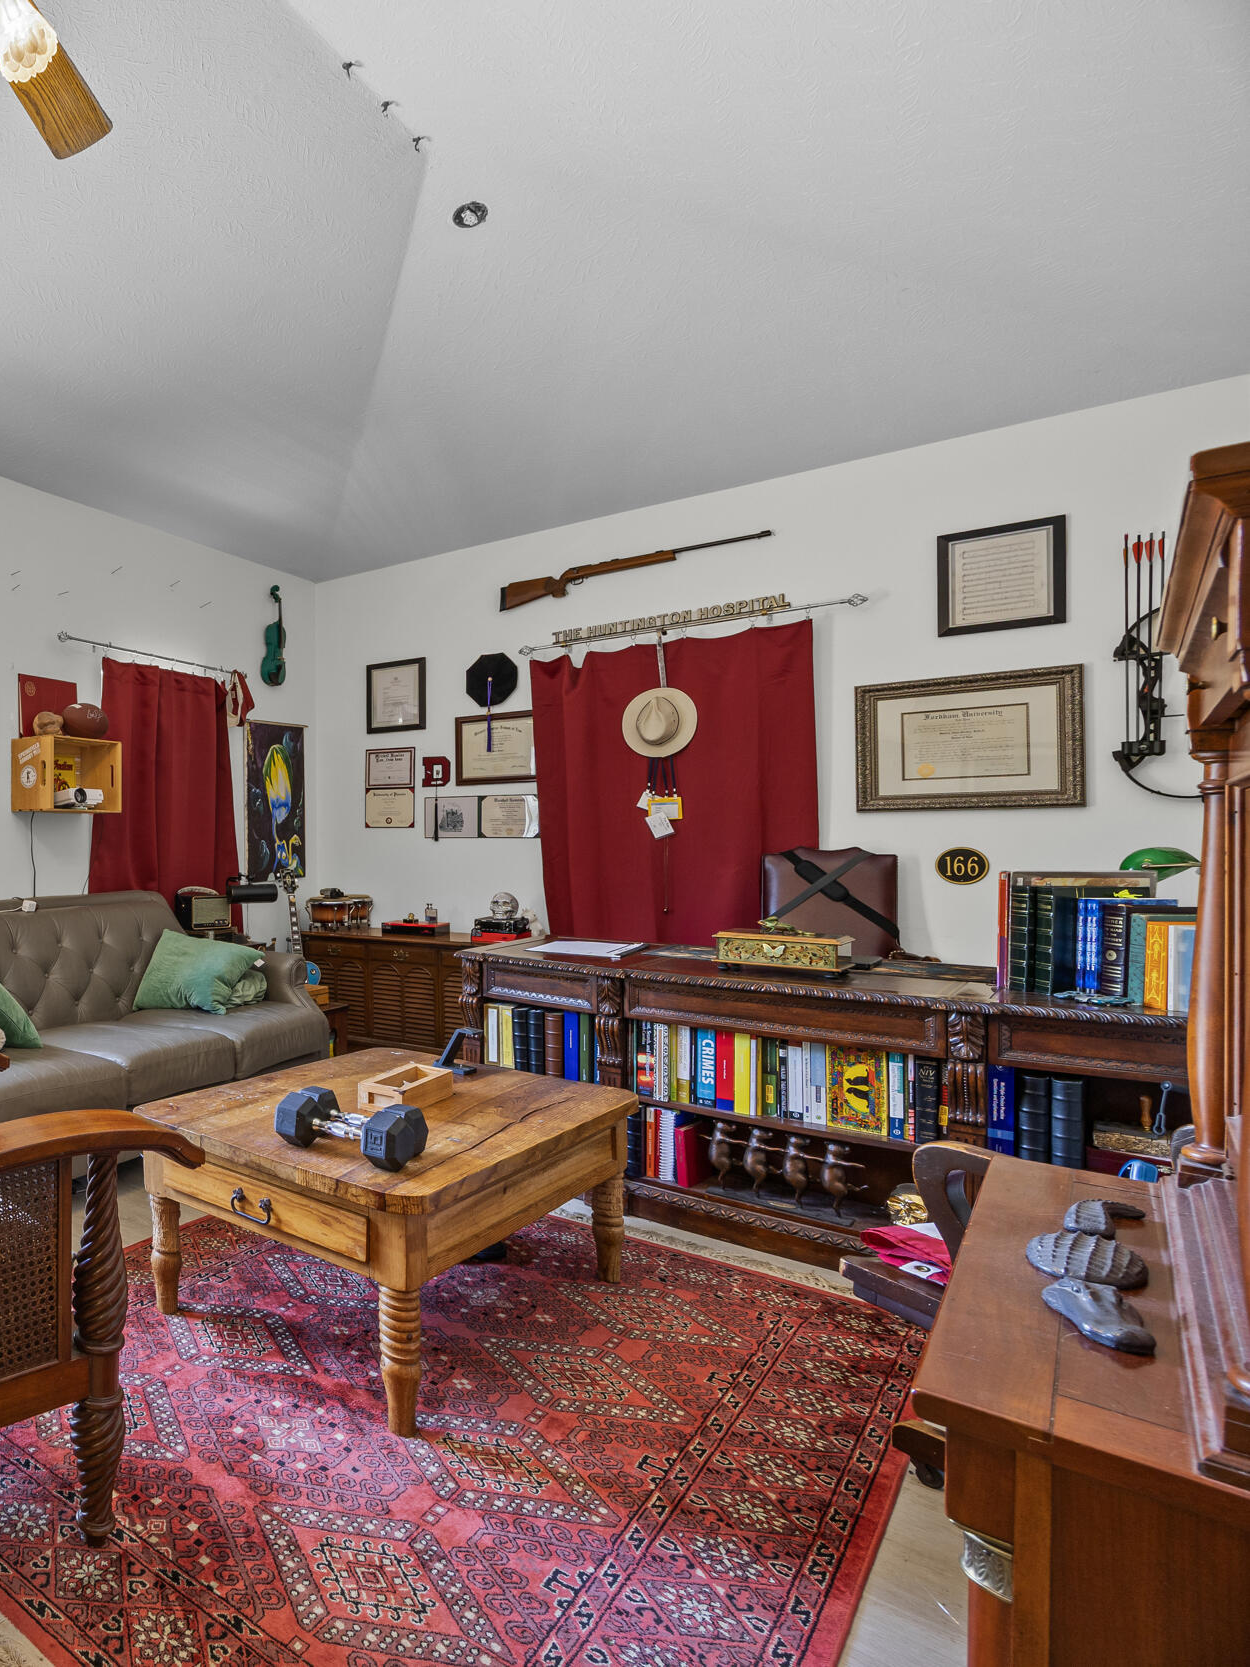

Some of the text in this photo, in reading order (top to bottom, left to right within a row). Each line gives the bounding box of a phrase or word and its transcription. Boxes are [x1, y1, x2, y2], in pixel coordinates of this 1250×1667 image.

[552, 593, 791, 644] THE HUNTINGTON HOSPITAL
[961, 709, 1003, 717] University
[422, 756, 451, 788] D
[945, 856, 979, 876] 166
[701, 1039, 715, 1085] CRIMES
[919, 1068, 935, 1076] NIV
